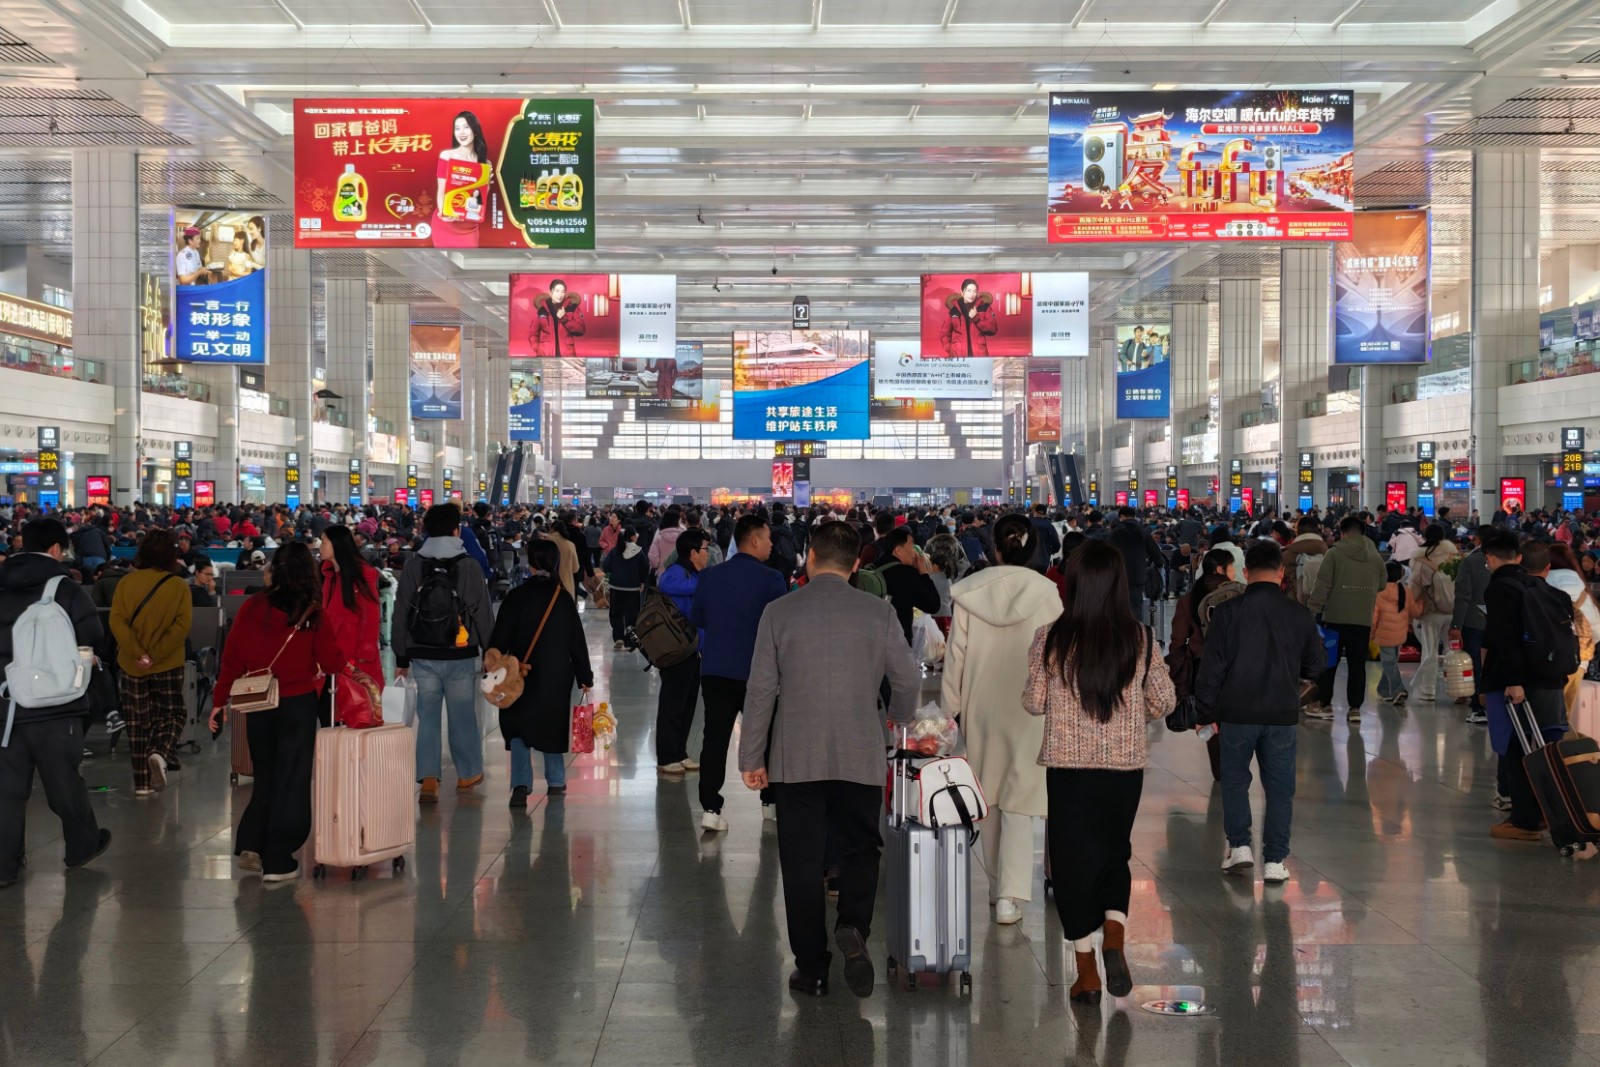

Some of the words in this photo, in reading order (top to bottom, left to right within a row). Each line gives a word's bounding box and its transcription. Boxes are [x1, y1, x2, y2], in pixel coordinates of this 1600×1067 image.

[1185, 108, 1237, 122] 海尔空调
[1240, 108, 1335, 122] 暖fufu的年货节
[314, 119, 398, 138] 回家看爸妈
[1217, 125, 1304, 133] 买海尔空调来京东MALL
[333, 134, 432, 156] 带上长寿花
[190, 300, 250, 312] 一言一行
[190, 312, 251, 326] 树形象
[190, 330, 250, 342] 一举一动
[191, 342, 251, 356] 见文明
[766, 406, 838, 418] 共享旅途生活
[766, 420, 838, 432] 维护站车秩序
